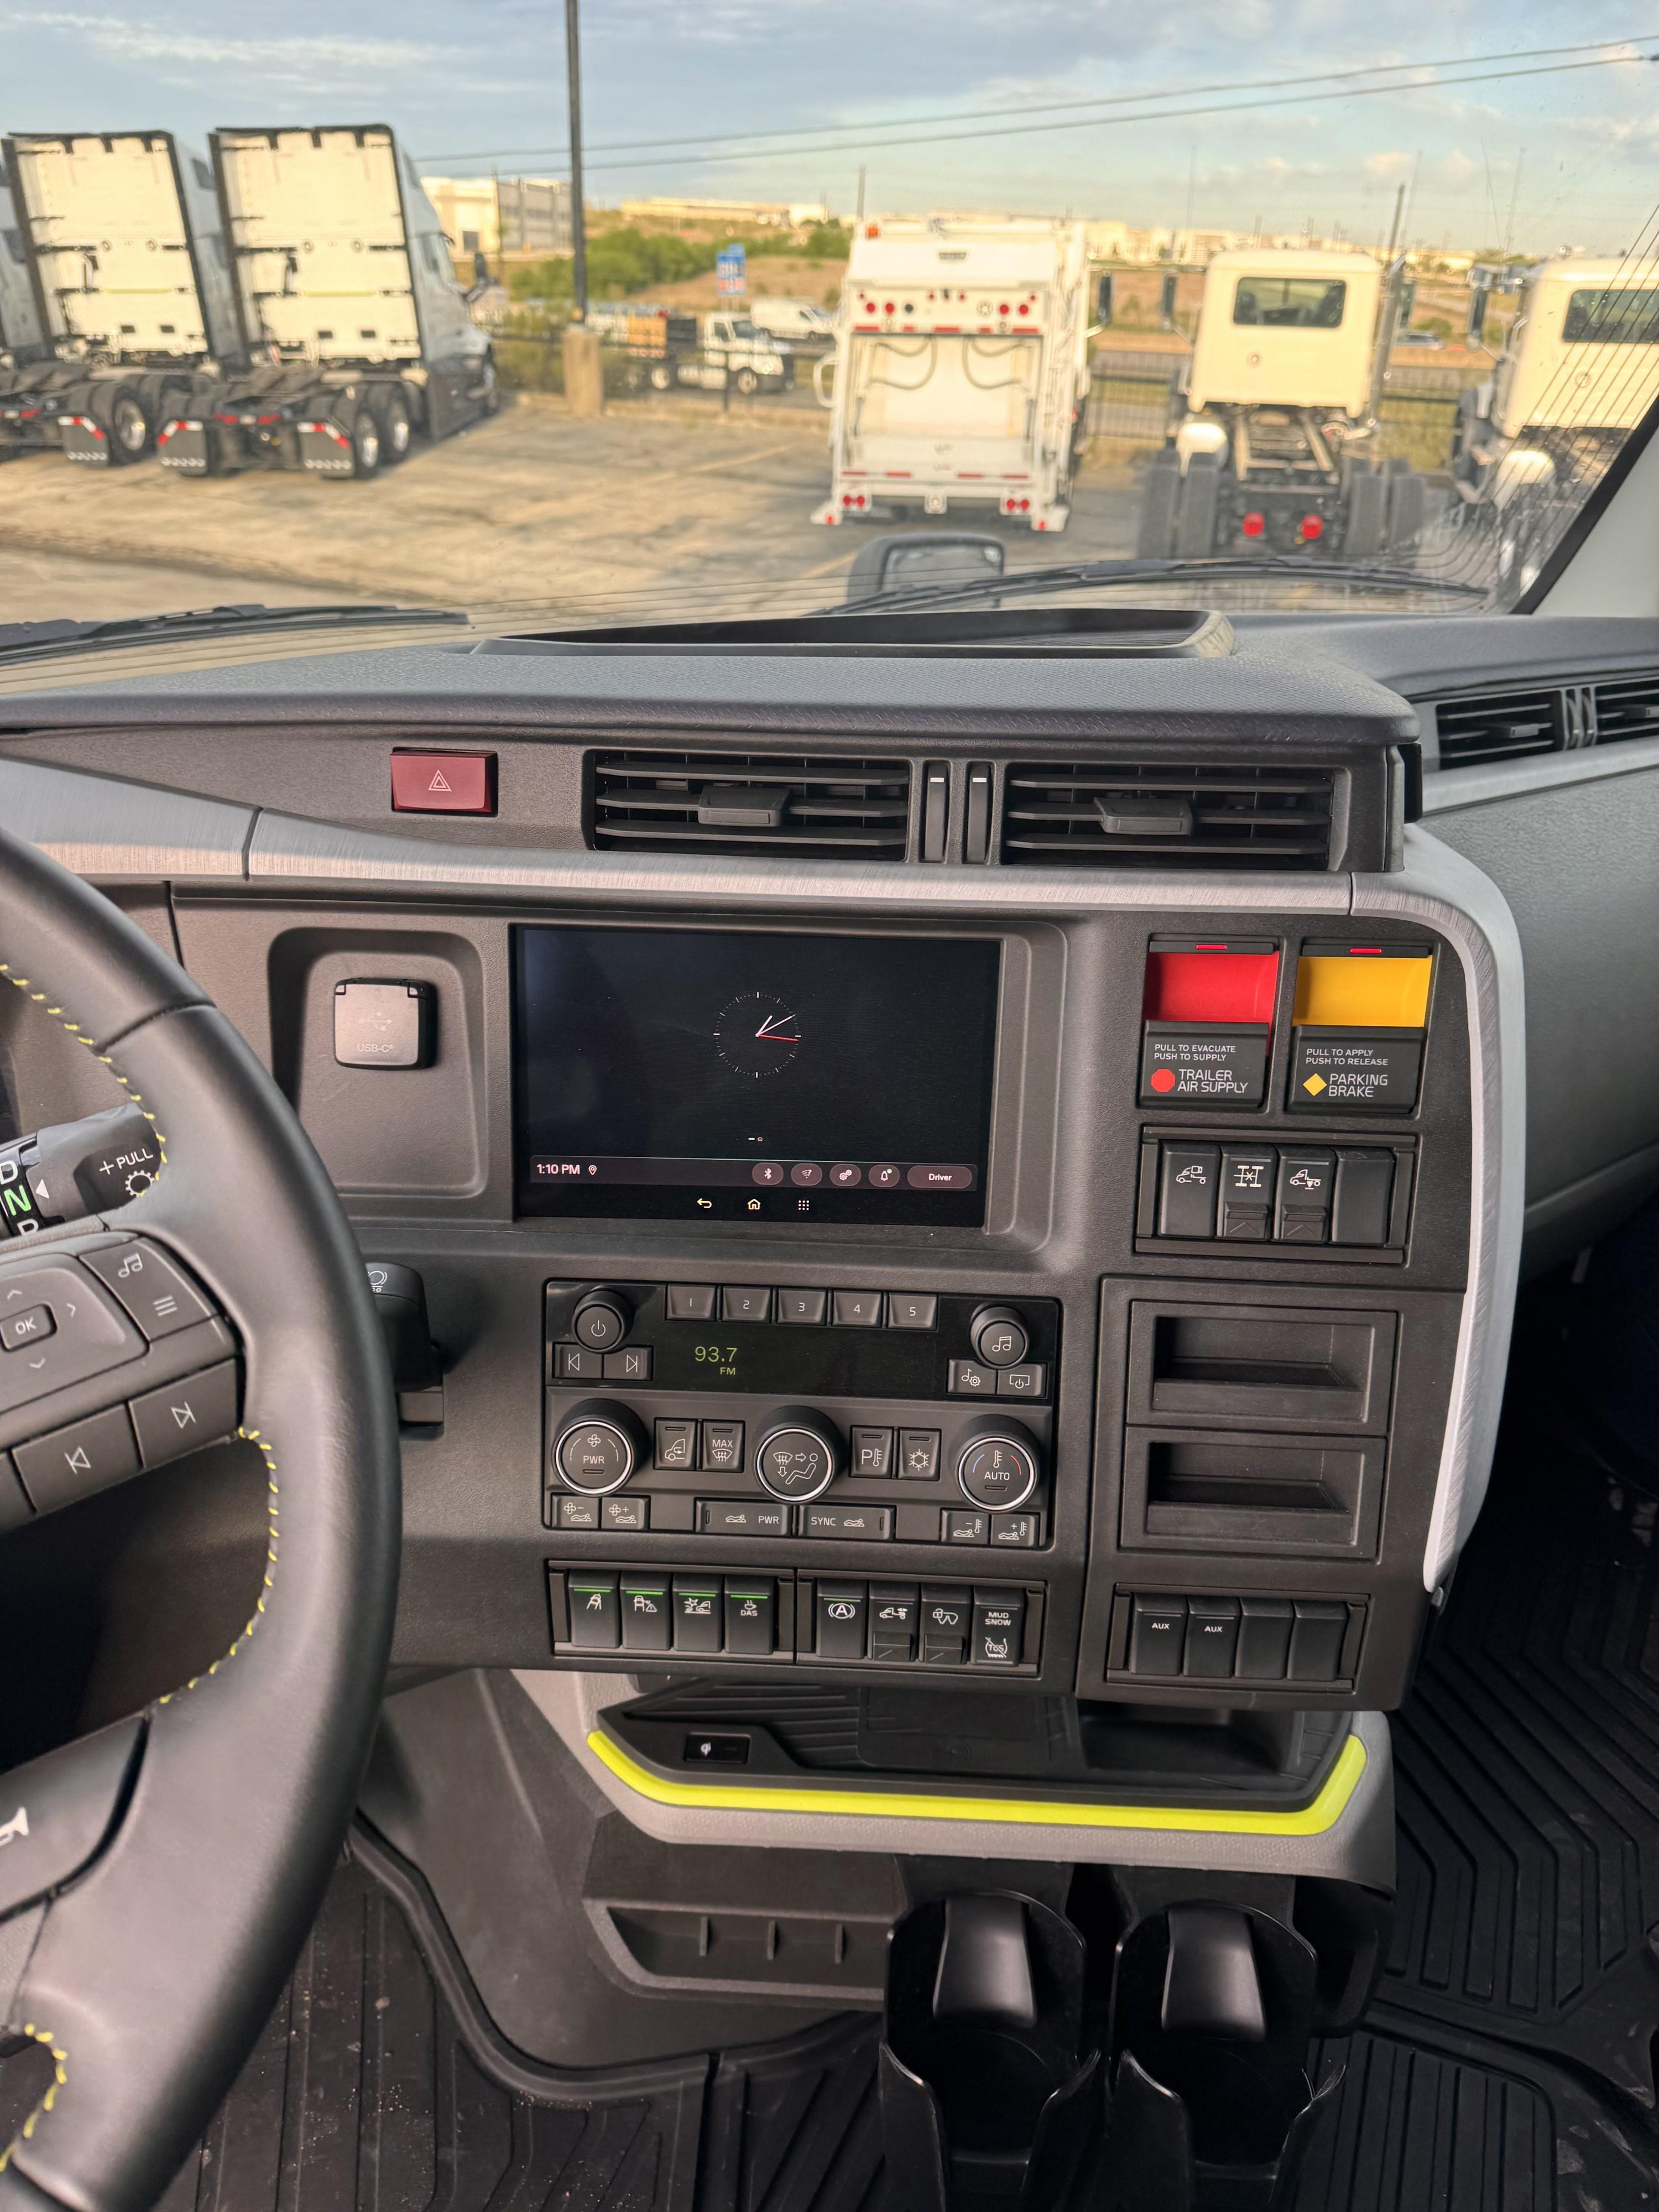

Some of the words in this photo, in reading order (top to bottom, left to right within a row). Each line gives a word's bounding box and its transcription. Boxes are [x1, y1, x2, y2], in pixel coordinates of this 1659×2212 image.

[1178, 1068, 1233, 1081] TRAILER
[1329, 1073, 1389, 1086] PARKING
[1177, 1081, 1198, 1092] AIR
[1201, 1081, 1248, 1093] SUPPLY
[1328, 1086, 1375, 1097] BRAKE
[116, 1148, 154, 1169] PULL
[0, 1160, 18, 1185] D
[536, 1164, 559, 1174] 1:10
[561, 1164, 580, 1175] PM
[928, 1173, 952, 1181] Driver
[4, 1185, 32, 1216] N
[742, 1300, 750, 1310] 2
[798, 1302, 806, 1312] 3
[853, 1304, 861, 1314] 4
[909, 1306, 916, 1316] 5
[15, 1316, 36, 1335] OK
[694, 1345, 738, 1363] 93.7
[720, 1367, 736, 1376] FM
[712, 1439, 733, 1448] MAX
[583, 1455, 604, 1464] PWR
[984, 1471, 1010, 1481] AUTO
[758, 1515, 779, 1525] PWR
[811, 1517, 837, 1526] SYNC
[984, 1618, 1011, 1626] SNOW
